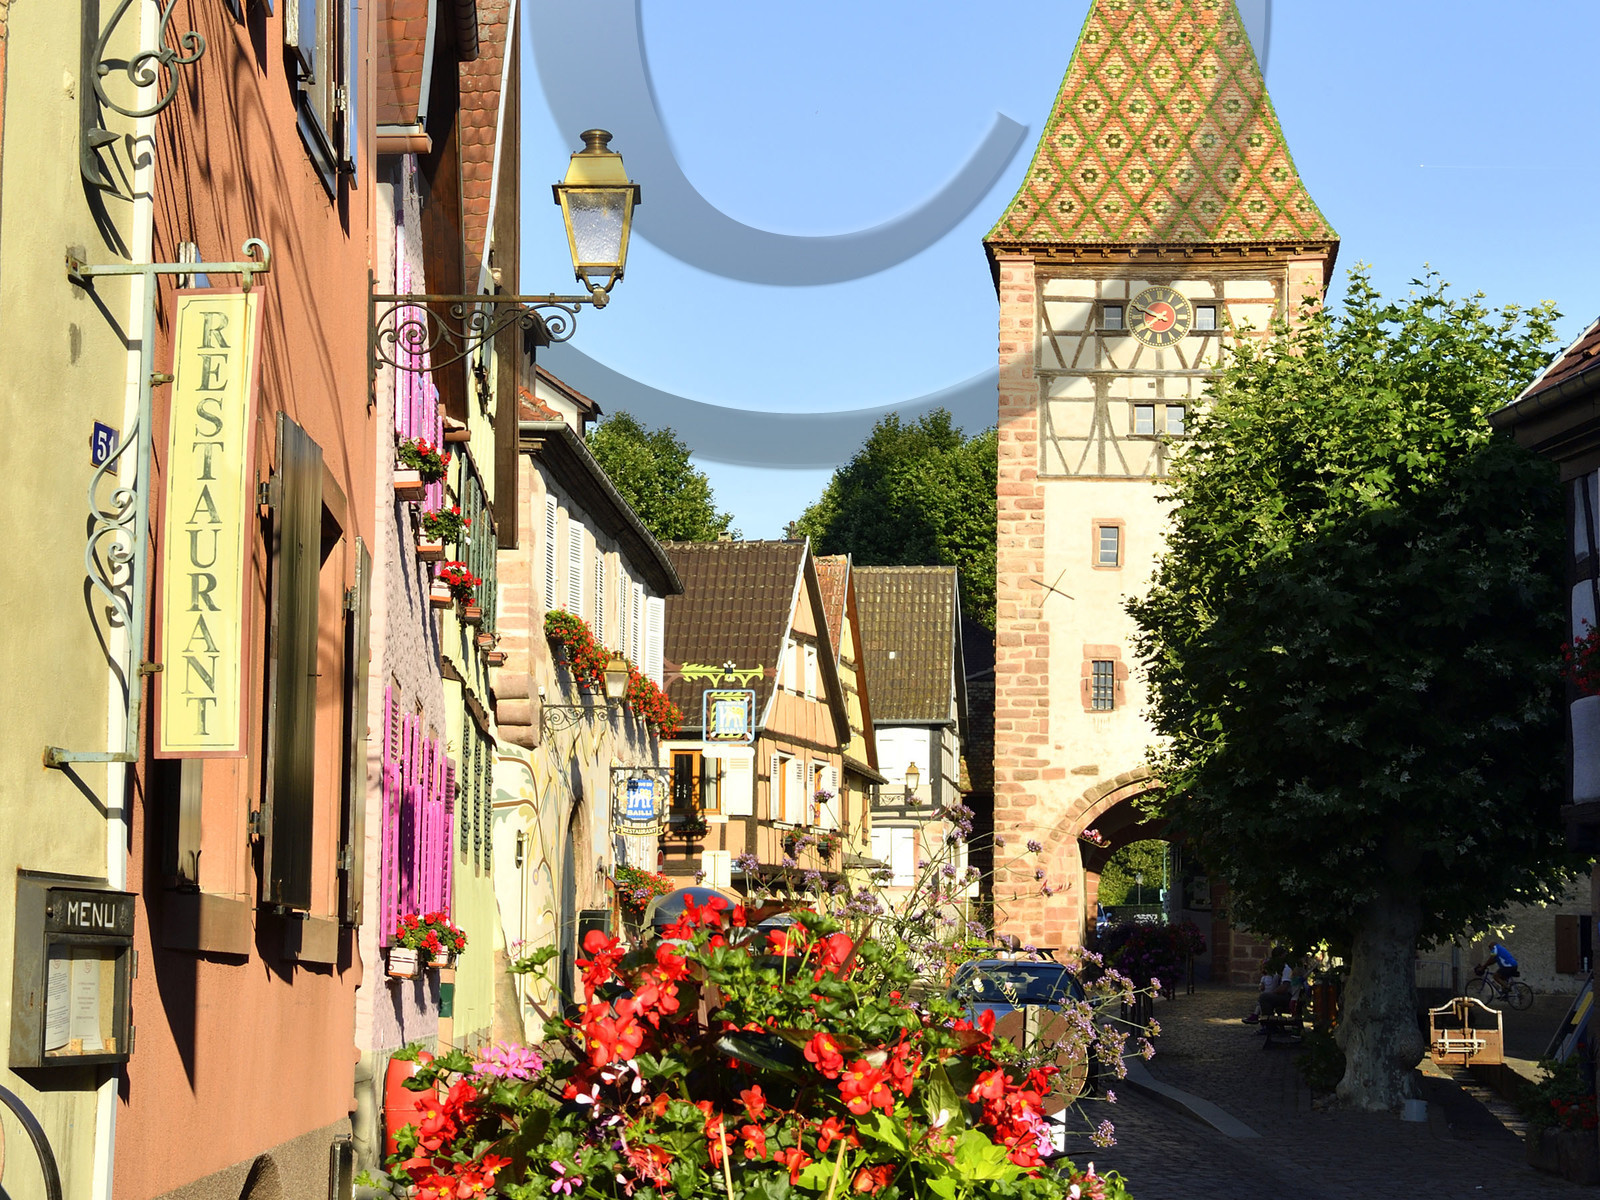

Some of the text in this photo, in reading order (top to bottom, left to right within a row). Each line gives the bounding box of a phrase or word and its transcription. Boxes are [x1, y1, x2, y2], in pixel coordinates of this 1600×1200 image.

[97, 430, 114, 466] 51
[181, 310, 231, 737] RESTAURANT
[67, 901, 116, 928] MENU
